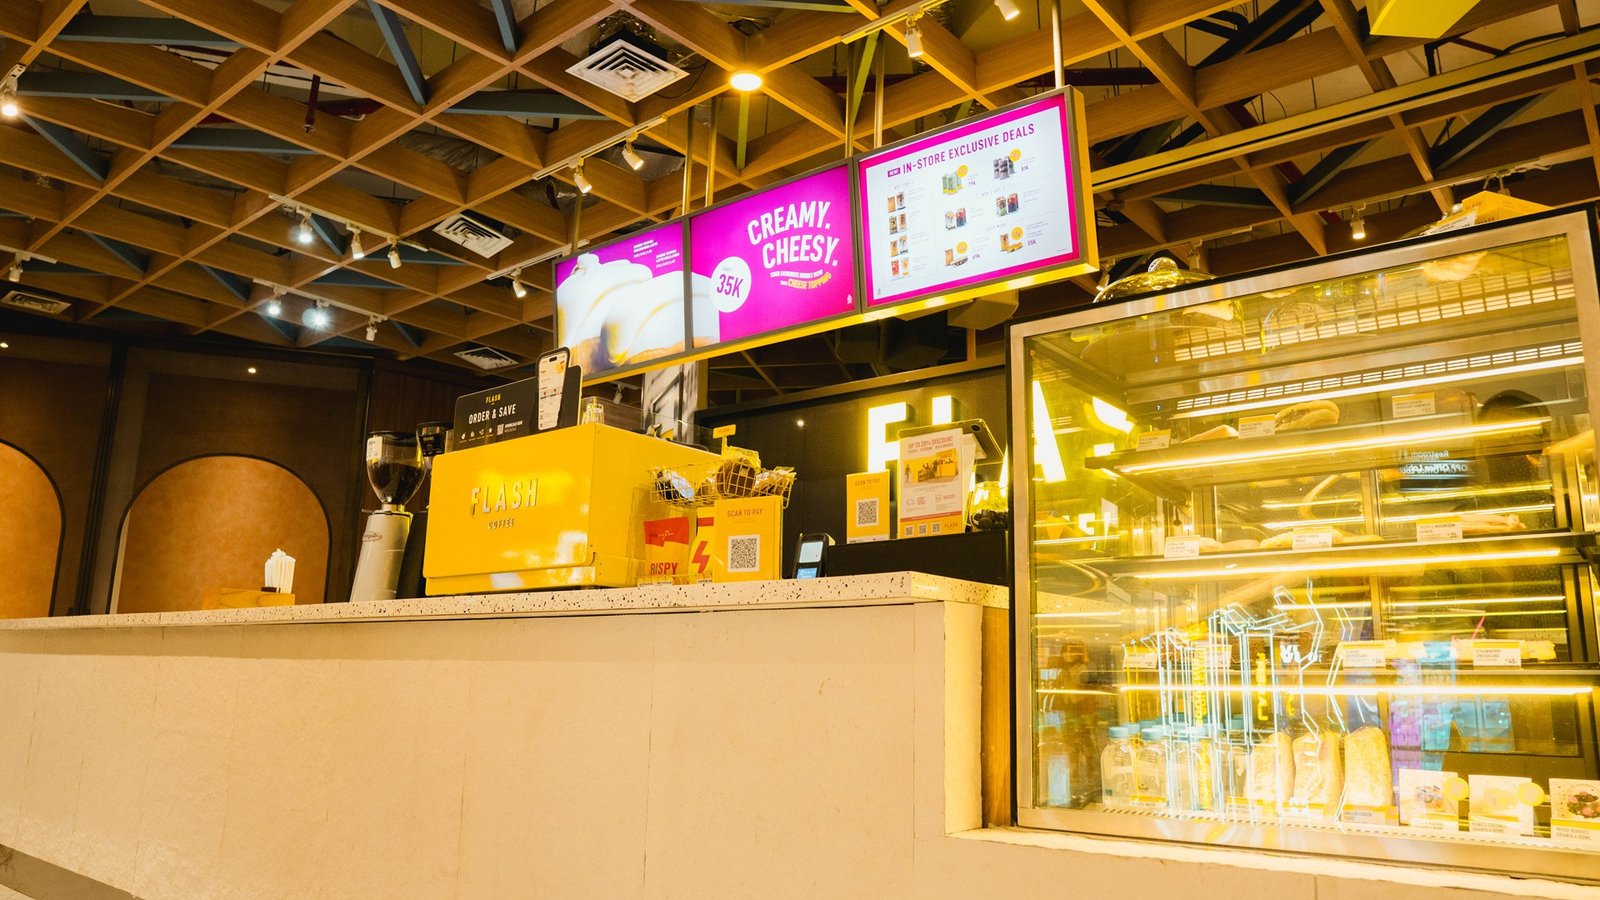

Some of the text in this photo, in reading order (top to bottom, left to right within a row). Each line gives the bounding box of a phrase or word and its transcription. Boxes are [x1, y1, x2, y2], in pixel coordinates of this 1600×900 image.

[903, 151, 945, 174] IN-STORE
[949, 134, 999, 159] EXCLUSIVE
[1002, 123, 1035, 142] DEALS
[747, 200, 831, 245] CREAMY.
[762, 234, 840, 269] CHEESY.
[716, 273, 744, 298] 35K
[485, 394, 502, 404] FLASH
[468, 403, 517, 425] ORDER & SAVE
[932, 436, 953, 446] DISCOUNT
[470, 477, 540, 516] FLASH
[488, 518, 515, 530] COFFEE
[727, 509, 742, 518] SCAN
